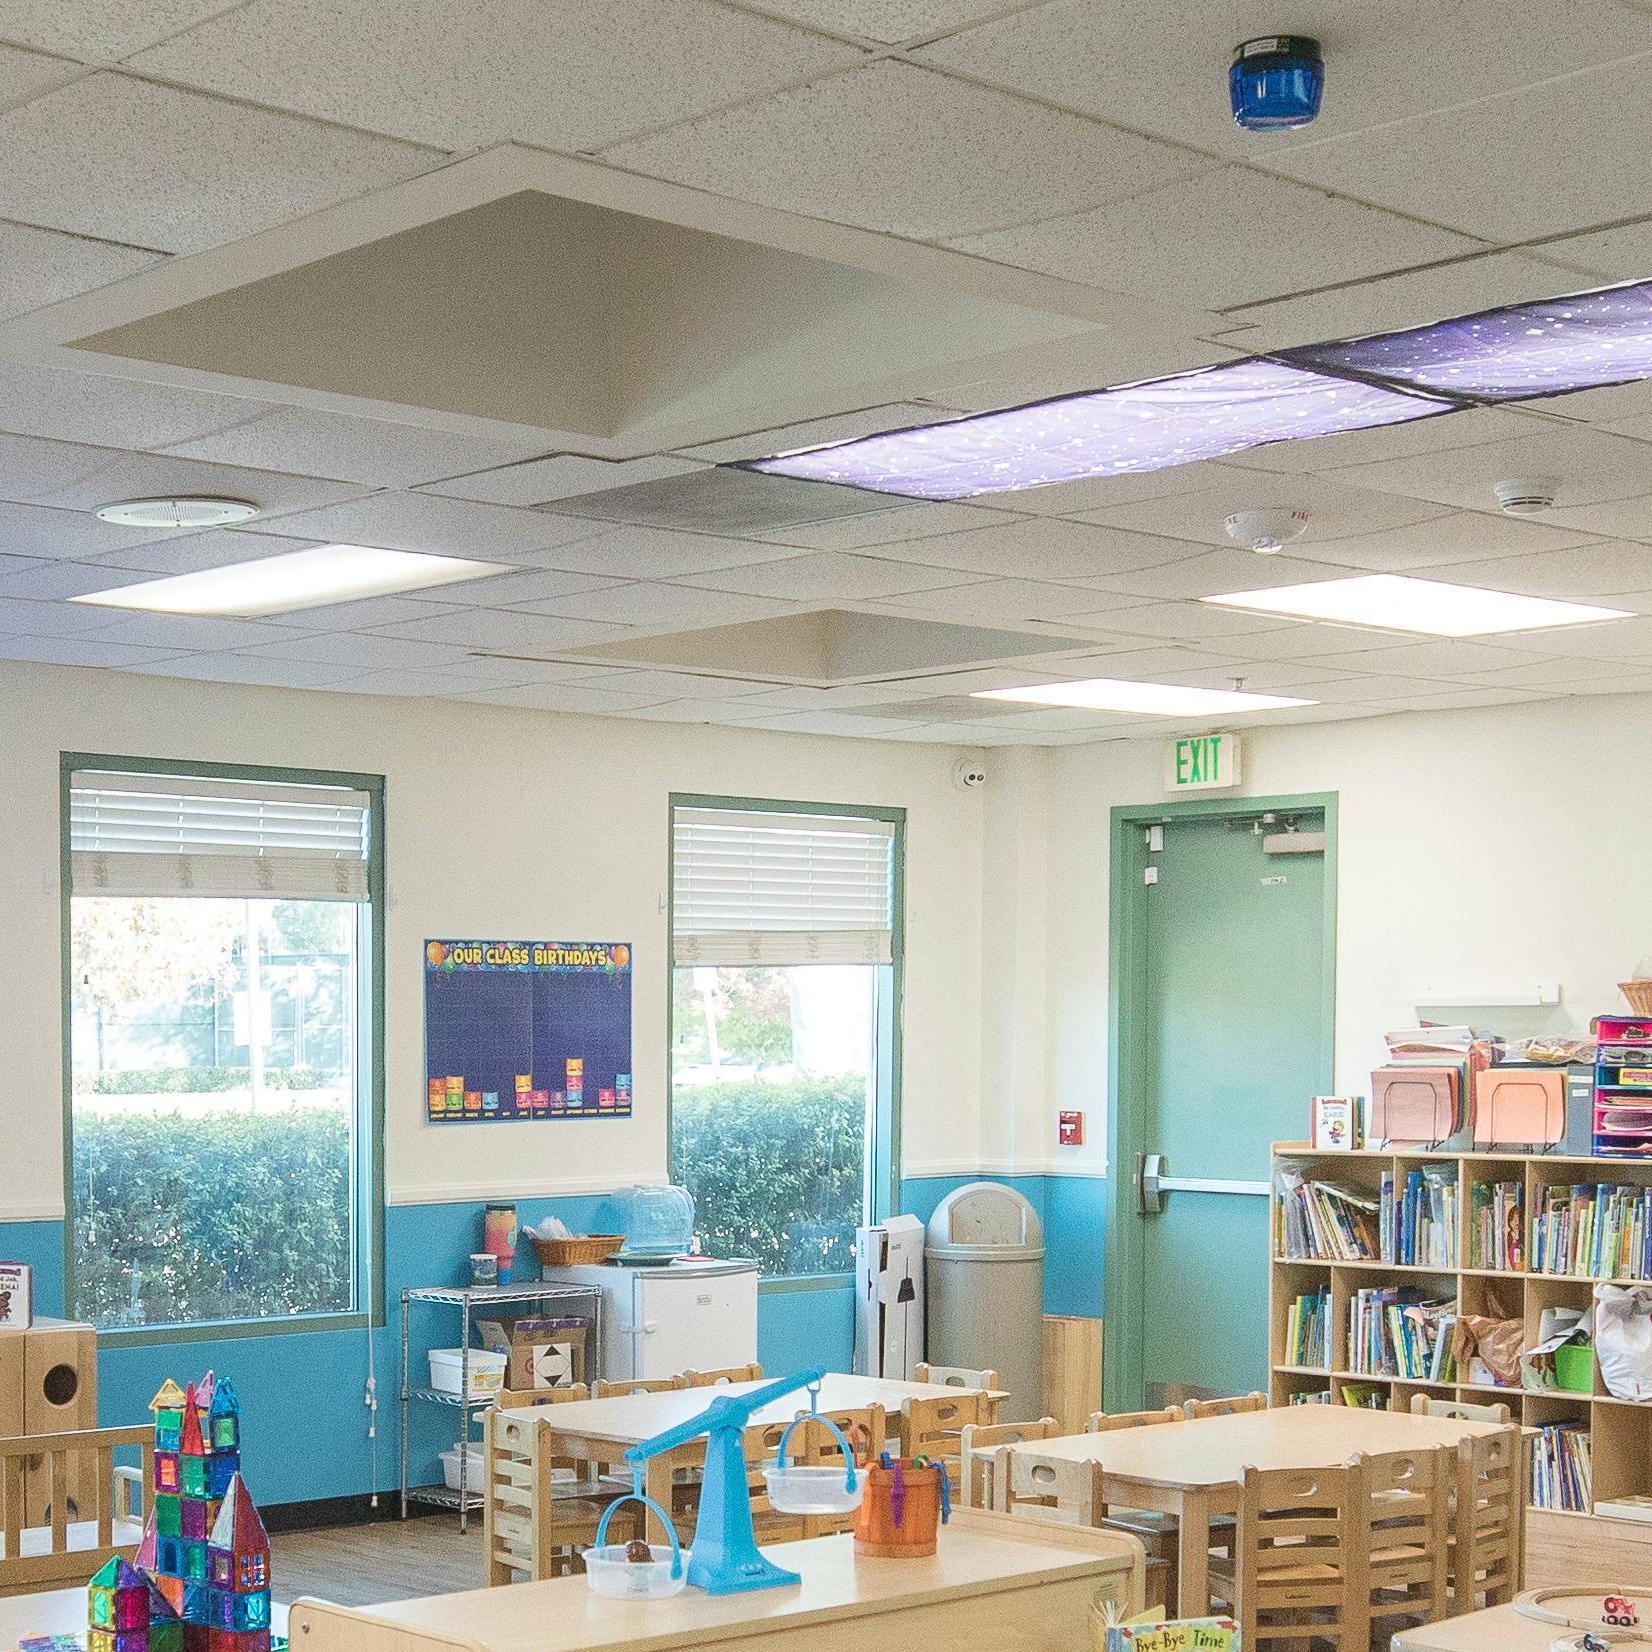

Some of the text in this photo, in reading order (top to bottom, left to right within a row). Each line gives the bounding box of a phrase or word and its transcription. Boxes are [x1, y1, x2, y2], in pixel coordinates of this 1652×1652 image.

[1176, 736, 1222, 785] EXIT
[453, 948, 608, 967] OUR CLASS BIRTHDAYS
[1193, 1629, 1225, 1649] Time
